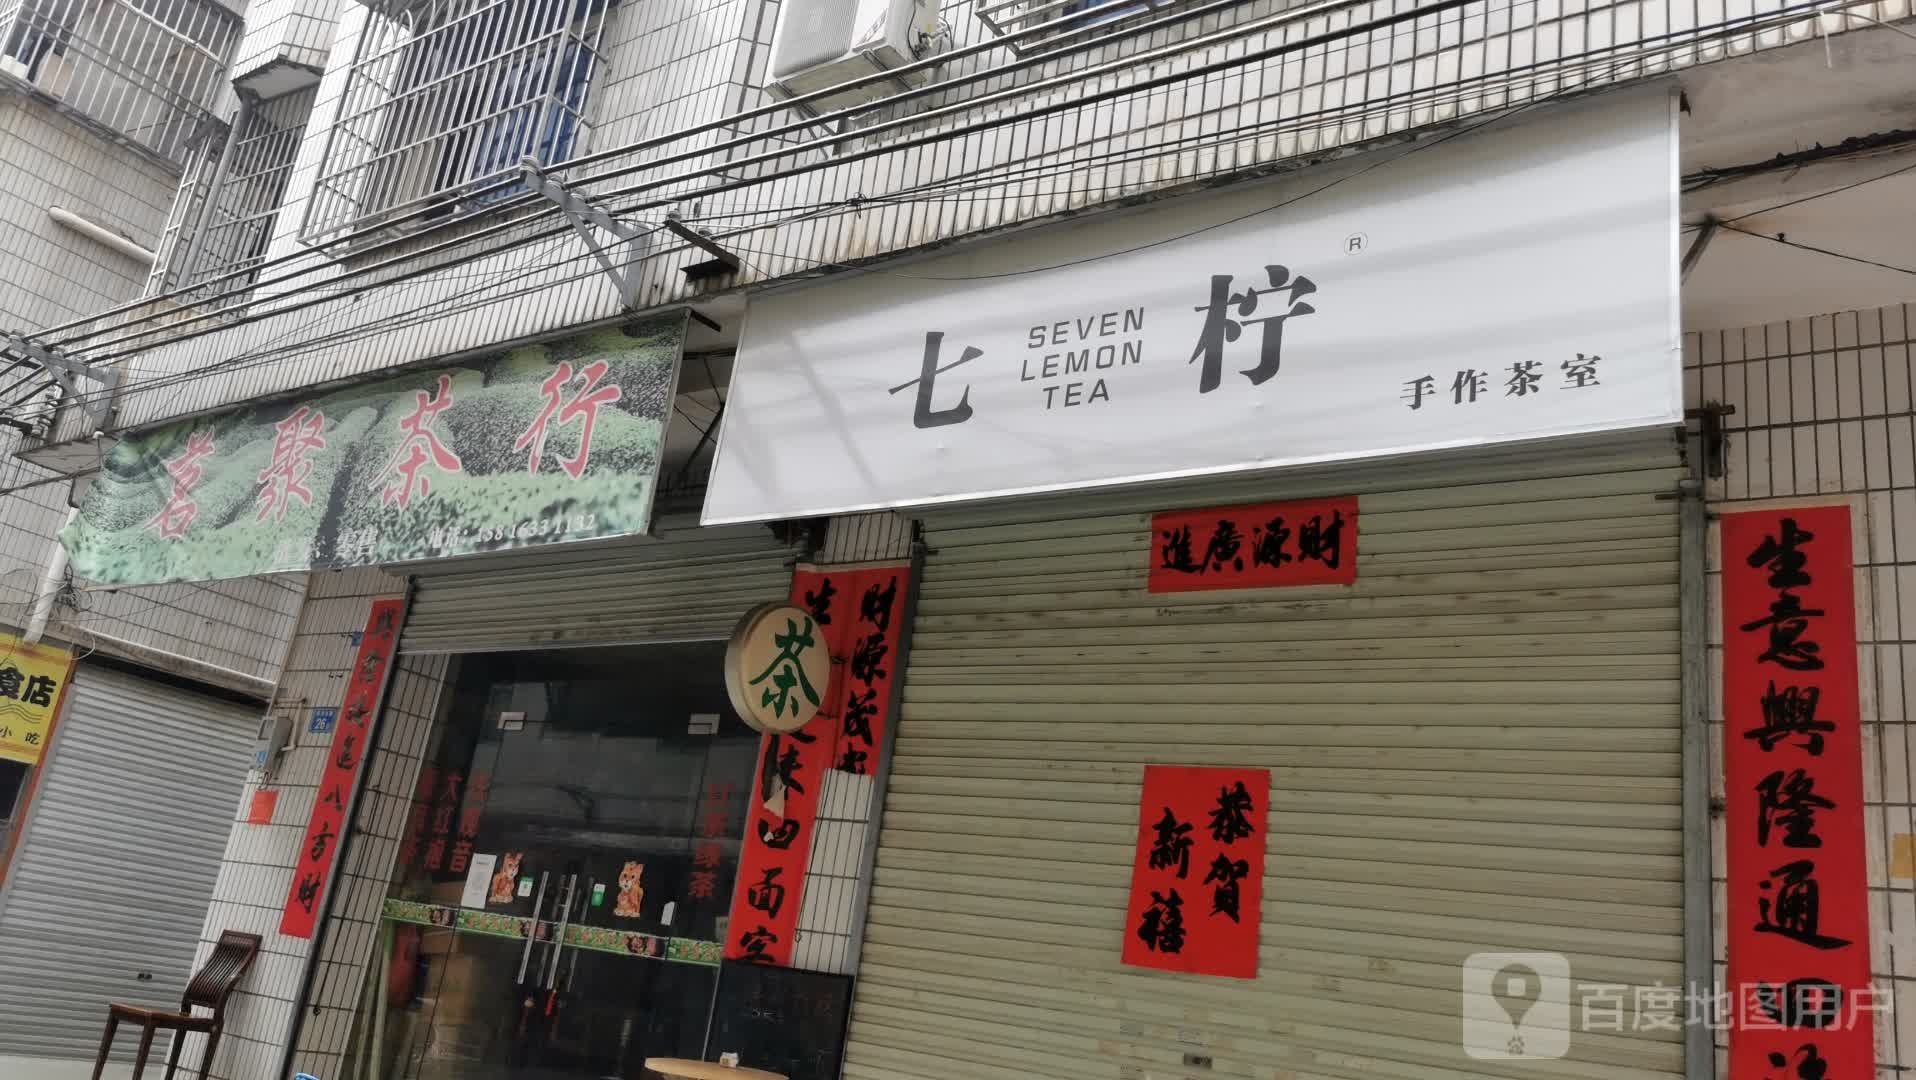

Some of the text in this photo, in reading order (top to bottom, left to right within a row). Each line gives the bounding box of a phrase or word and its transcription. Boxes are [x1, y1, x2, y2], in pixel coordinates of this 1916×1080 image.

[888, 264, 1318, 430] 七 柠
[1027, 306, 1145, 348] SEVEN
[1020, 339, 1144, 382] LEMON
[1399, 353, 1603, 411] 手作茶室
[1042, 382, 1111, 411] TEA
[143, 358, 622, 540] 茗聚茶行
[749, 615, 821, 719] 茶
